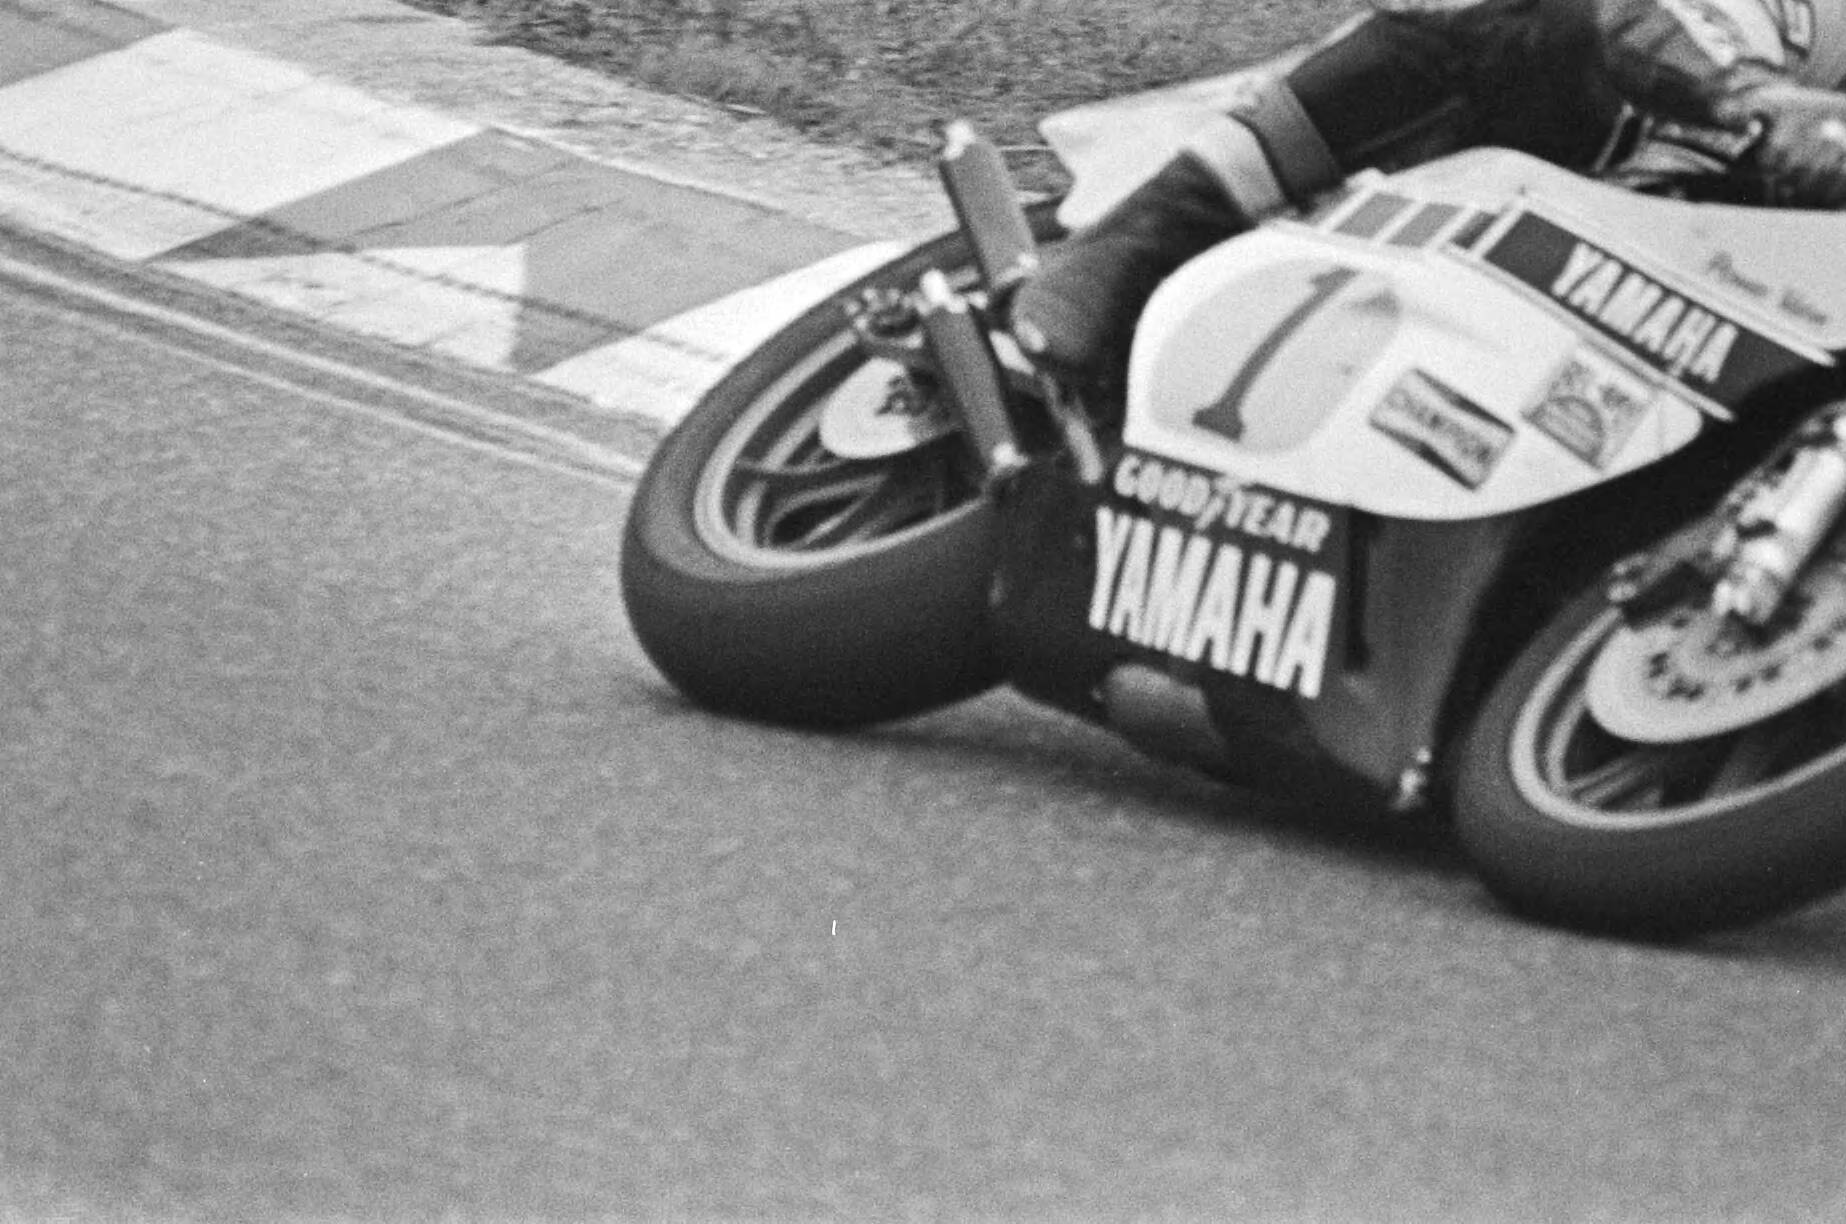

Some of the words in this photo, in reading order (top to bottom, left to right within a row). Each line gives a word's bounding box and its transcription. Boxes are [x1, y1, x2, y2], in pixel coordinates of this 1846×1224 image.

[1191, 265, 1361, 442] 1
[1550, 241, 1739, 384] YAMAHA
[1088, 505, 1337, 700] YAMAHA
